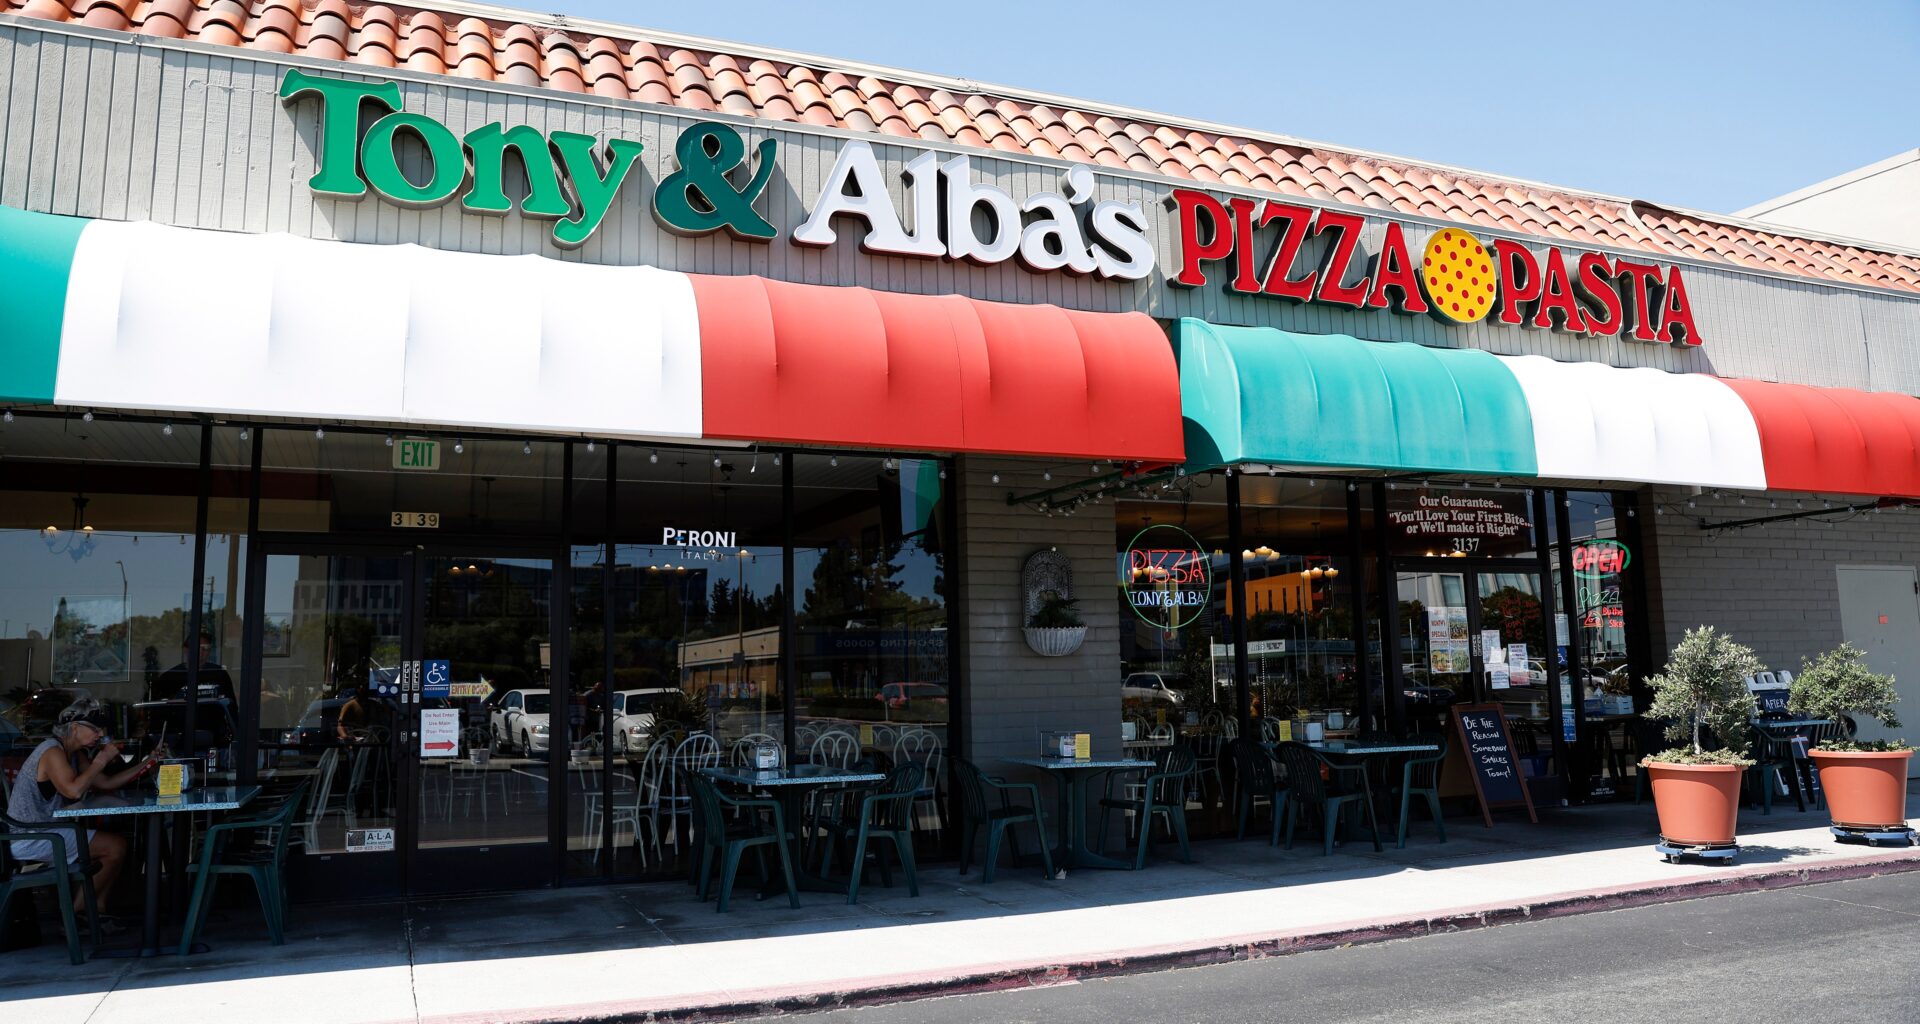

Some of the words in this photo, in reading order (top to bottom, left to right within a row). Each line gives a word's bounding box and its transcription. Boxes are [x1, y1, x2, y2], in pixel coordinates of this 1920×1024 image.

[279, 68, 644, 248] Tony
[651, 121, 778, 241] &
[792, 138, 1155, 281] Alba's
[1164, 188, 1428, 314] PIZZA
[1492, 238, 1703, 347] PASTA
[400, 441, 435, 467] EXIT
[1419, 495, 1440, 508] Our
[1441, 495, 1503, 509] Guarantee...
[1389, 510, 1424, 523] "You'll
[1425, 509, 1449, 521] Love
[1450, 510, 1476, 522] Your
[1477, 510, 1503, 523] First
[1504, 512, 1534, 528] Bite...
[662, 526, 737, 548] PERONI
[1406, 525, 1418, 534] or
[1420, 522, 1446, 534] We'll
[1446, 522, 1475, 534] make
[1475, 522, 1486, 534] it
[1486, 524, 1519, 537] Right"
[1452, 537, 1480, 552] 3137
[1131, 549, 1205, 583] PIZZA
[1572, 546, 1625, 573] OPEN
[451, 685, 471, 695] ENTRY
[472, 684, 488, 694] DOOR
